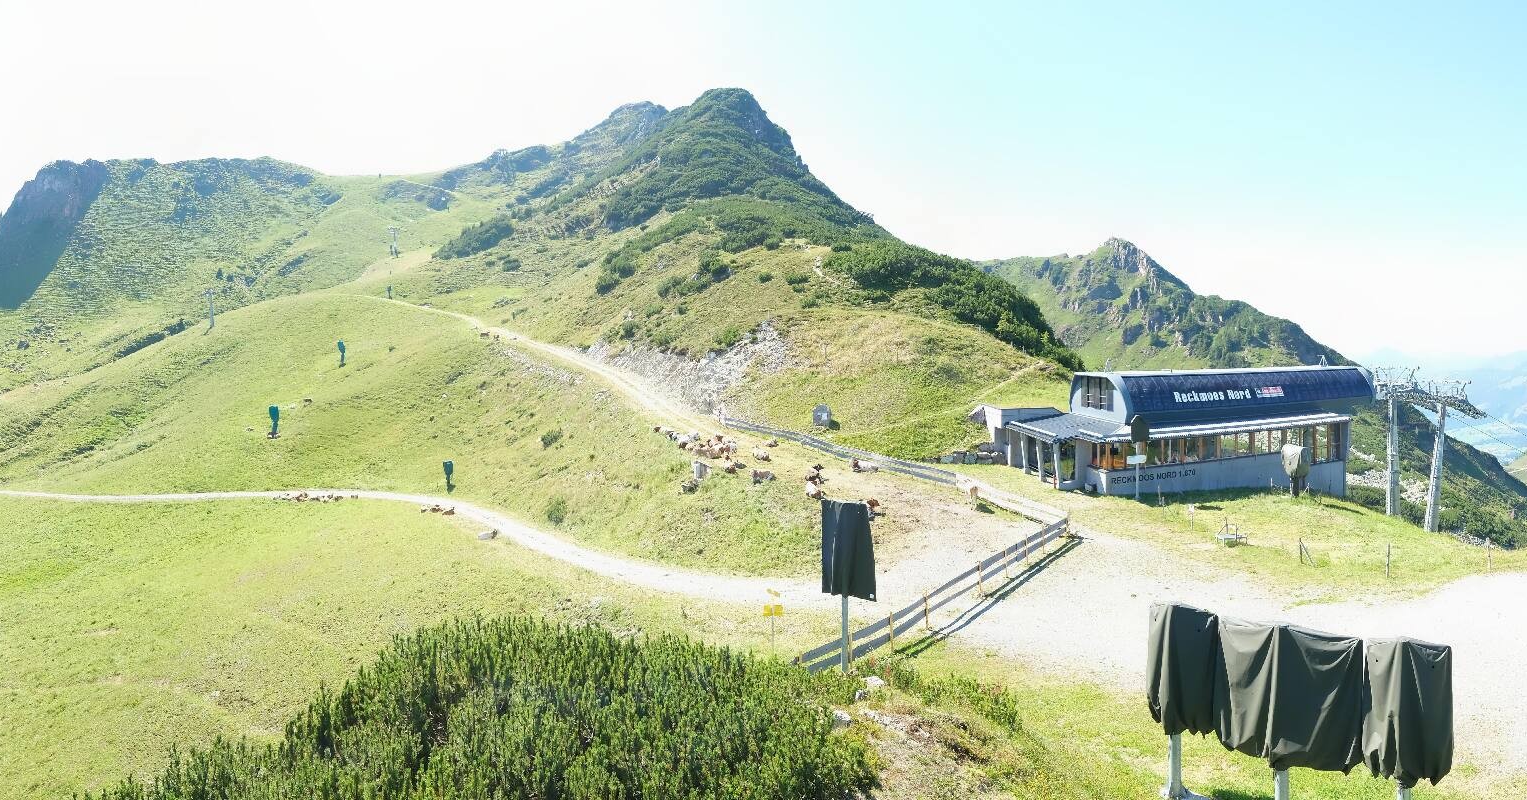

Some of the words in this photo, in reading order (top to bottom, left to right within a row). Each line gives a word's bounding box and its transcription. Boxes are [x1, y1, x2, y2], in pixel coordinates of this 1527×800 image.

[1174, 391, 1225, 402] Reckmoos
[1226, 388, 1251, 400] Nord
[1156, 471, 1176, 480] NORD
